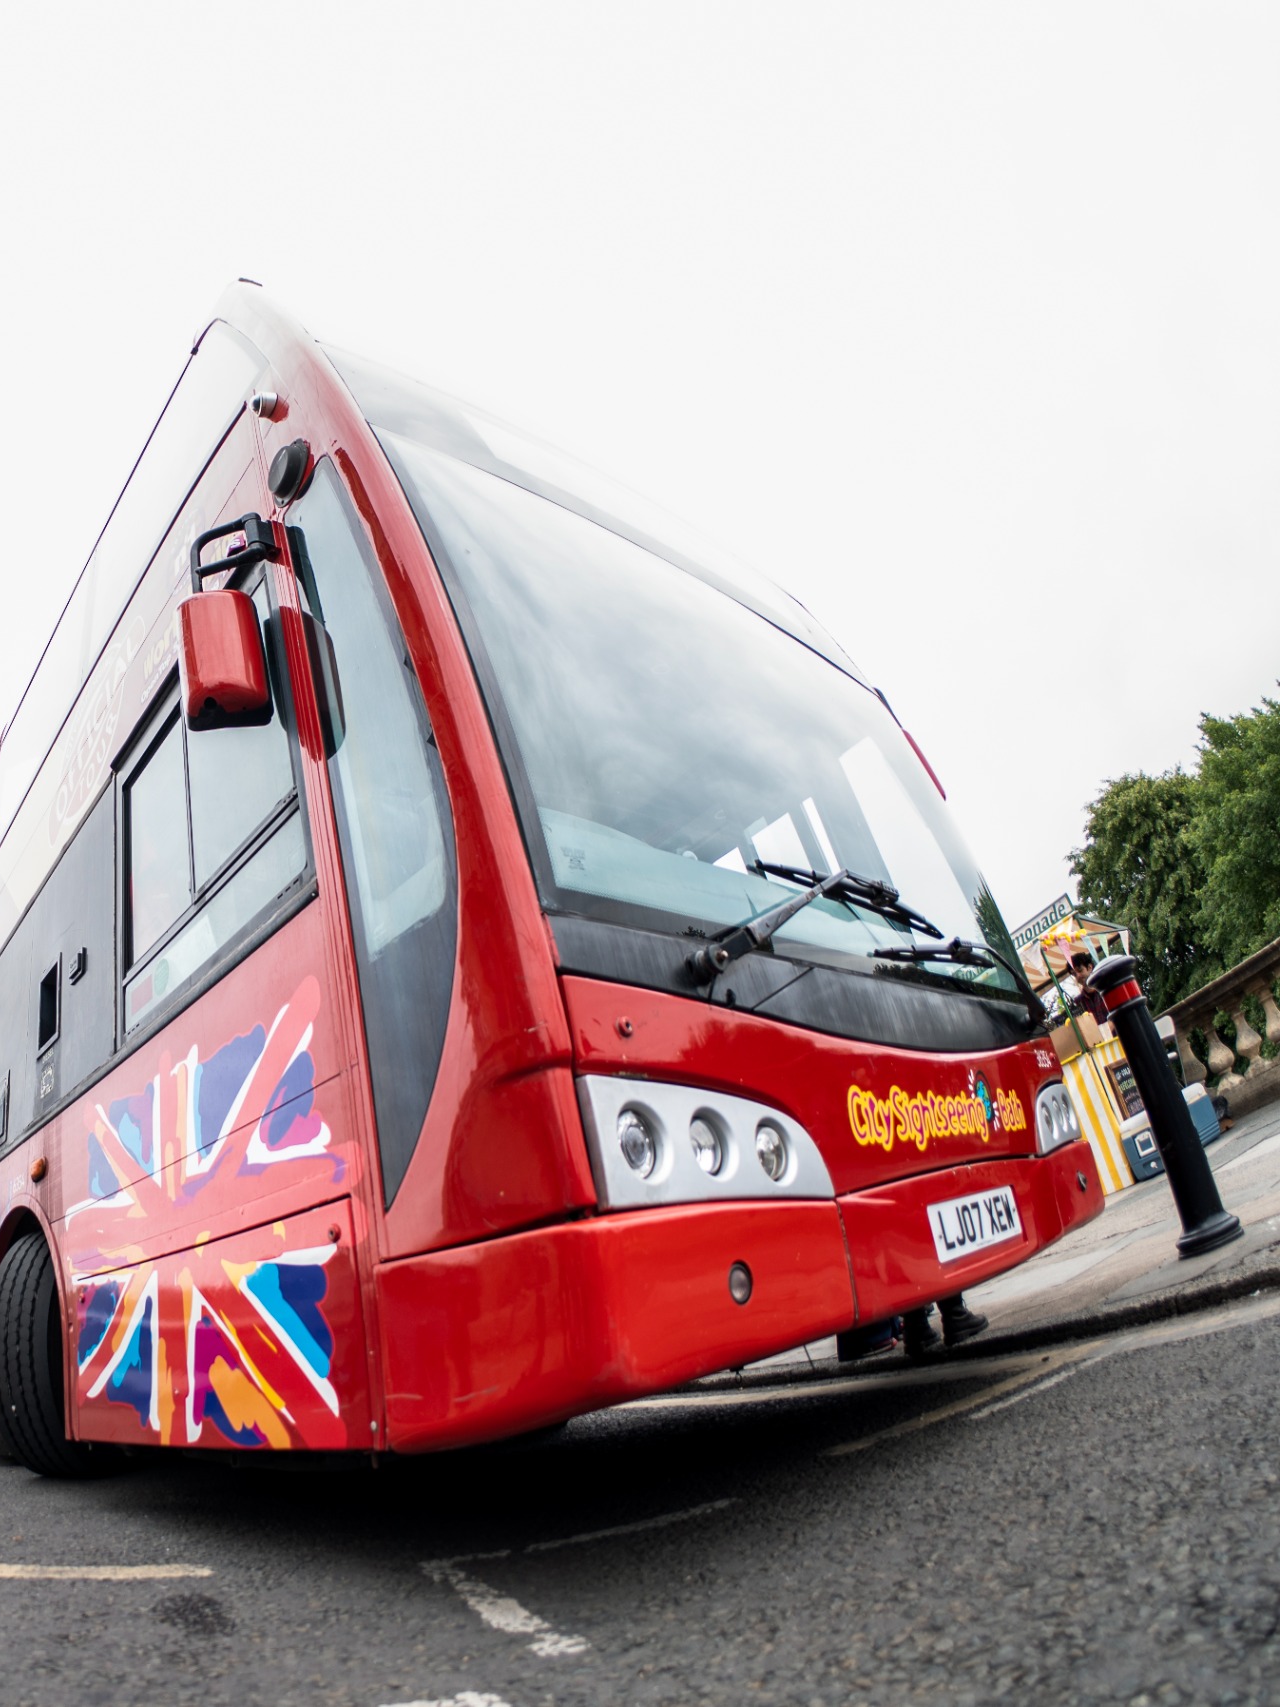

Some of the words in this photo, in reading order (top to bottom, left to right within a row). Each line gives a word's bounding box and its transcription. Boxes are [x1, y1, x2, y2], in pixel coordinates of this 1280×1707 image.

[56, 634, 141, 822] OFFICIAL
[78, 712, 119, 802] TOUR
[996, 1088, 1027, 1131] Bath
[937, 1201, 984, 1251] LJ07
[983, 1193, 1016, 1236] XEW
